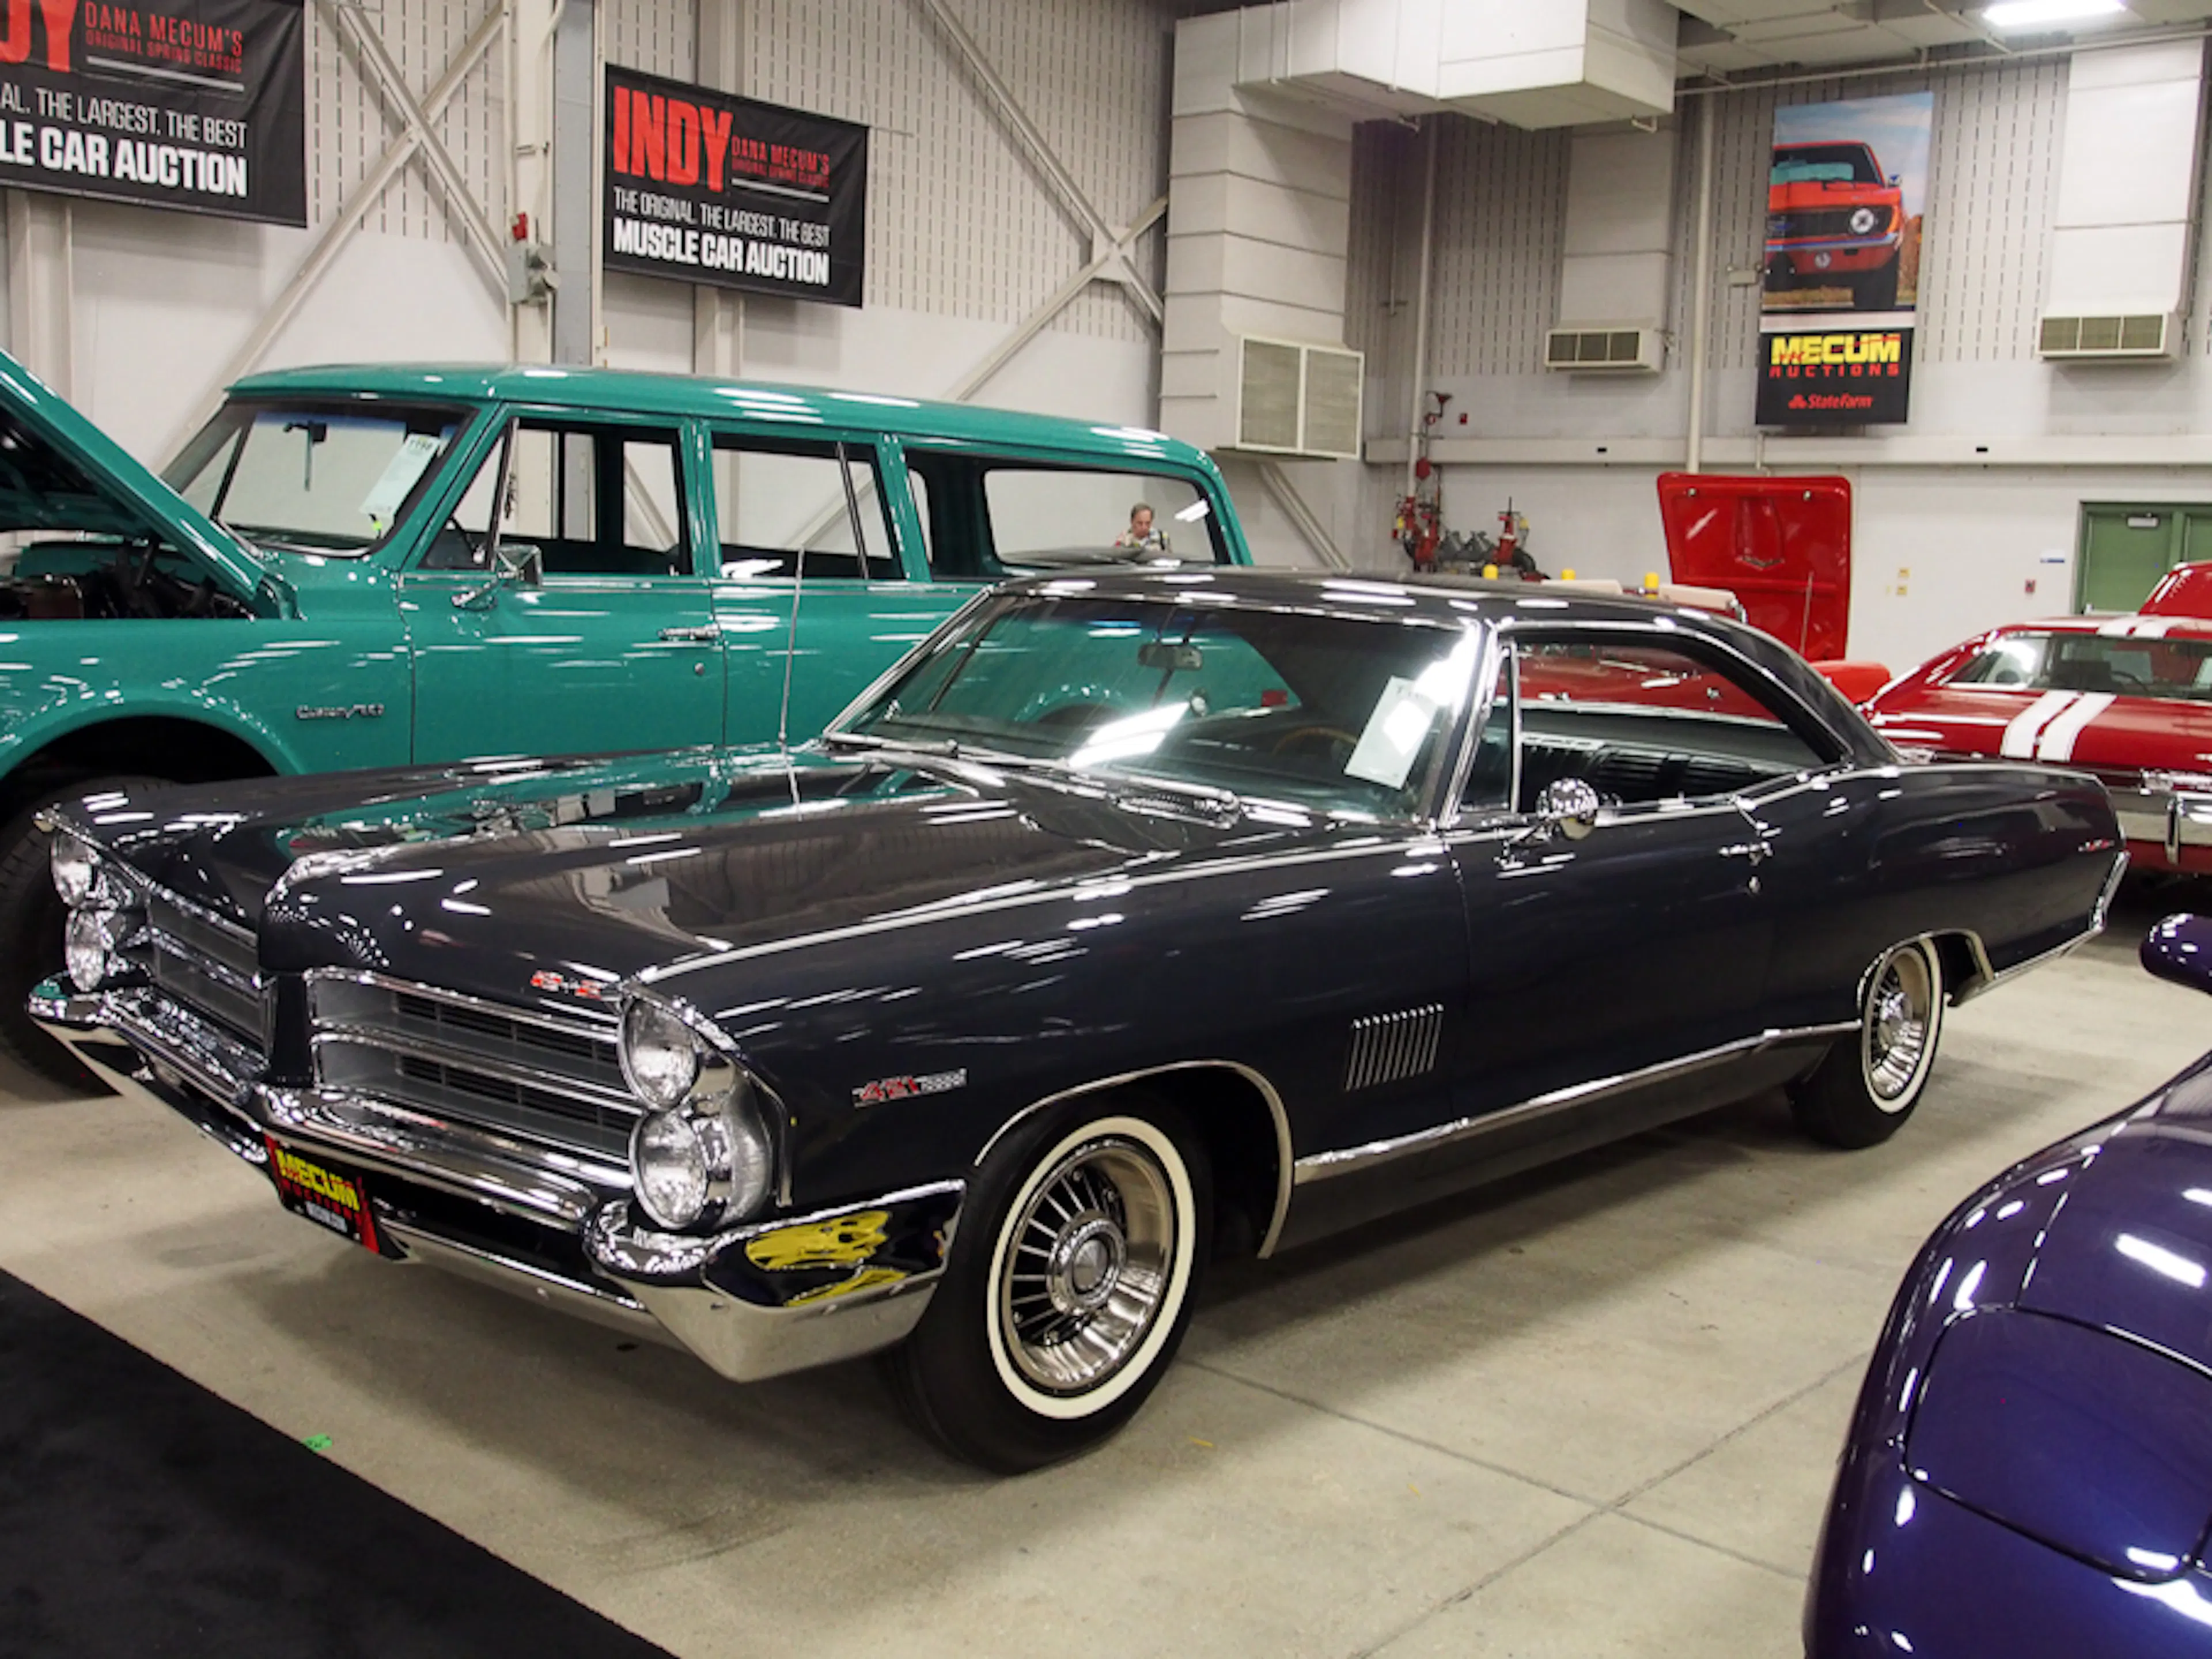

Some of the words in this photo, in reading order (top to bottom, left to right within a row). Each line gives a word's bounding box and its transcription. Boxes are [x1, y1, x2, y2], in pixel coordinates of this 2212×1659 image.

[85, 1, 142, 37] DANA
[149, 13, 243, 57] MECUM'S
[35, 87, 73, 122] THE
[77, 96, 162, 137] LARGEST.
[165, 109, 199, 142] THE
[203, 116, 248, 149] BEST
[613, 85, 733, 193] INDY
[40, 126, 111, 177] CAR
[113, 138, 248, 198] AUCTION
[731, 135, 768, 162] DANA
[770, 144, 830, 176] MECUM'S
[613, 185, 638, 214] THE
[699, 203, 723, 229] THE
[778, 217, 800, 243] THE
[800, 222, 831, 248] BEST
[612, 217, 699, 264] MUSCLE
[700, 232, 745, 272] CAR
[745, 241, 831, 286] AUCTION
[1768, 362, 1900, 378] AUCTIONS
[1770, 332, 1902, 365] MECUM
[275, 1148, 361, 1212] MECUM
